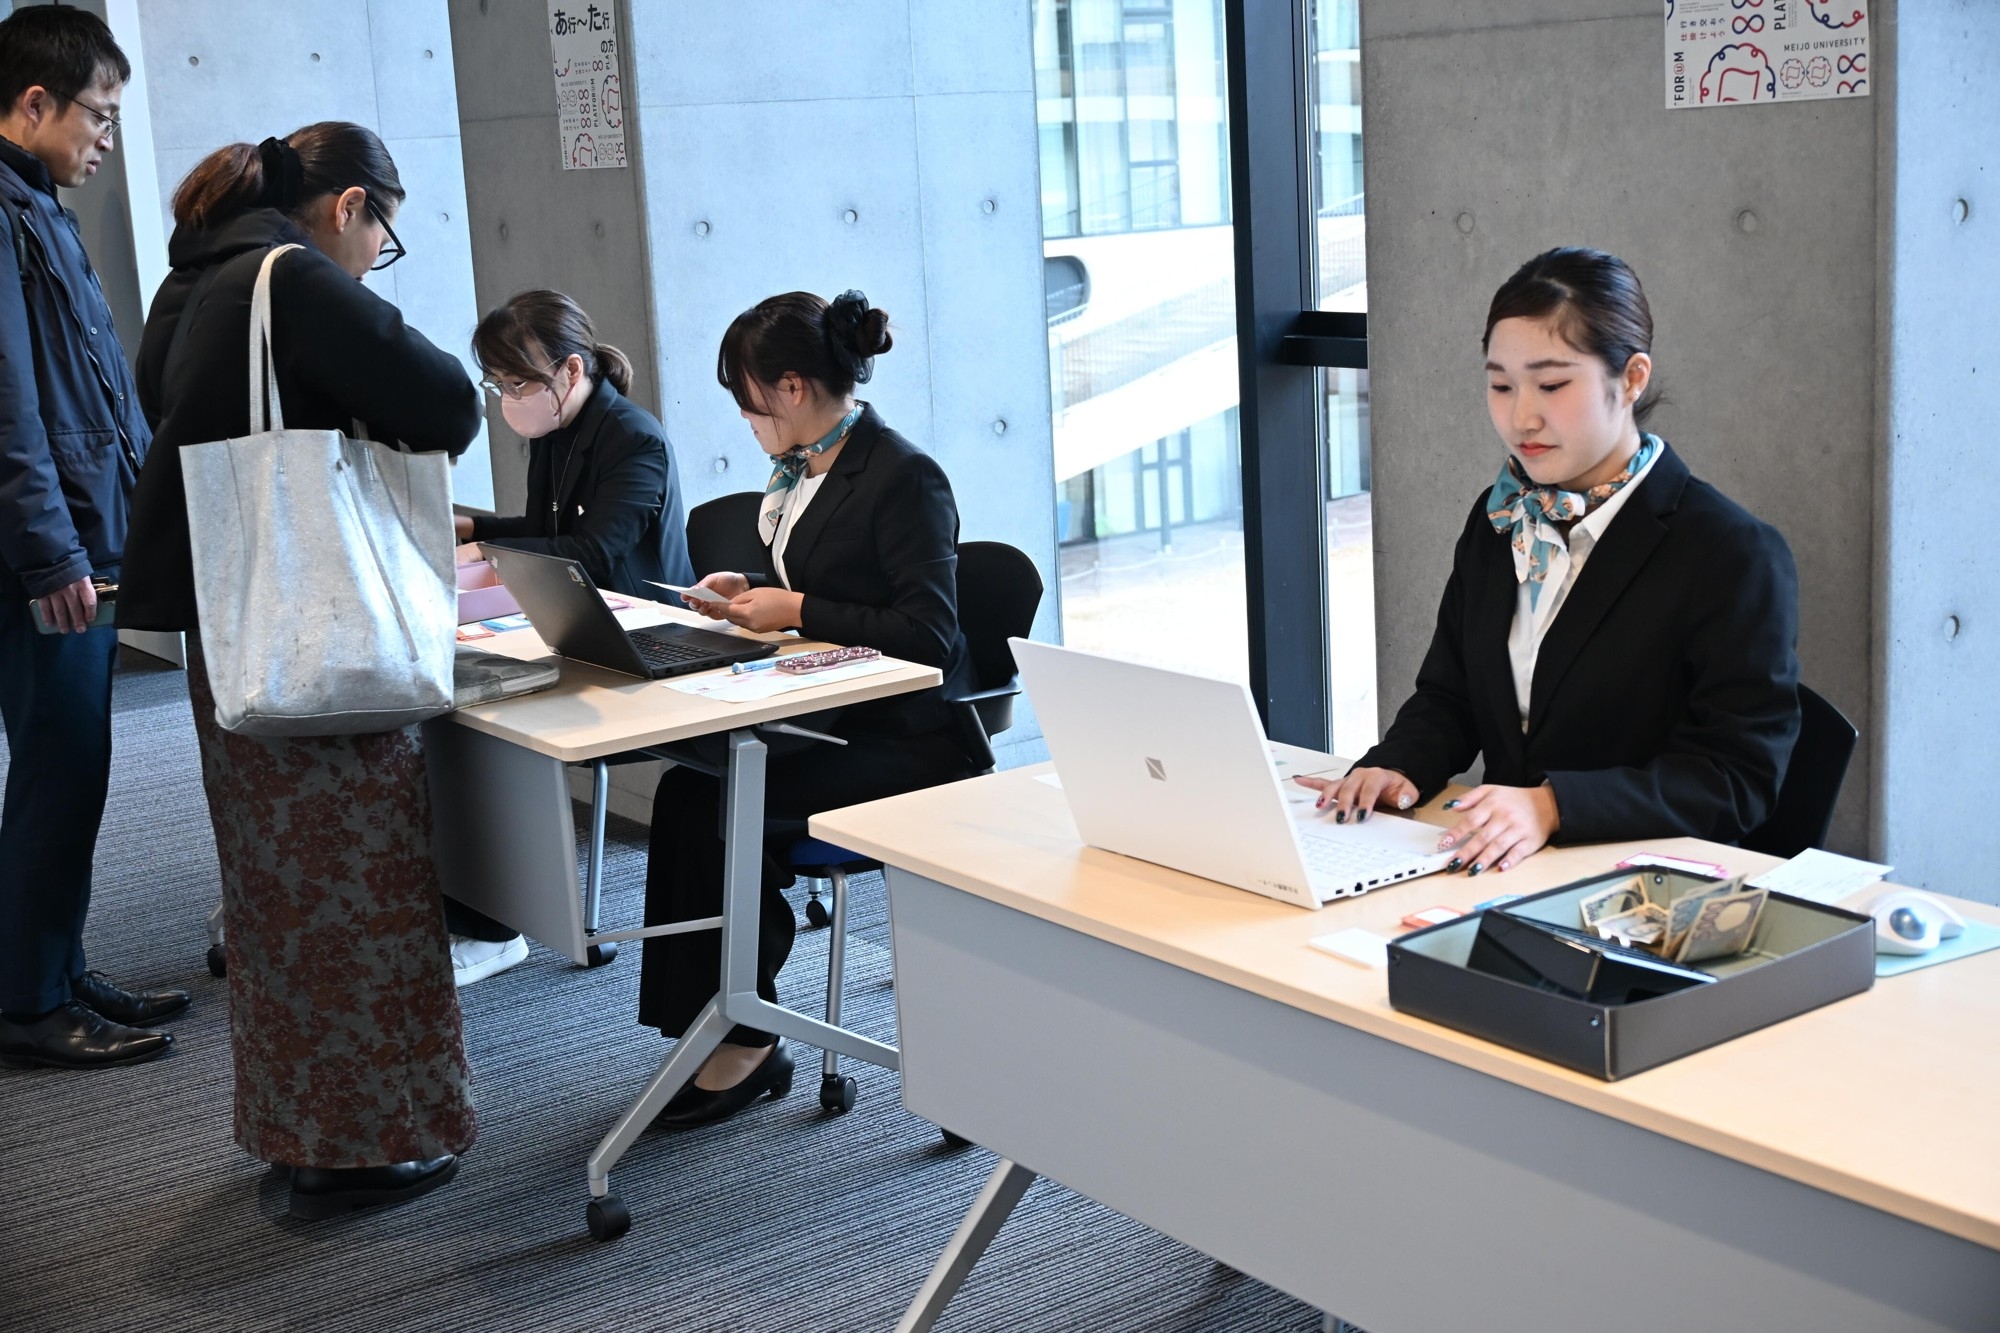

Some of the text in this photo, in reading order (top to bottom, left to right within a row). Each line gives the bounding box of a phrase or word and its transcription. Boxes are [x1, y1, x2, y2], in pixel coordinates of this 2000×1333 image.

[601, 38, 614, 53] の方
[1783, 37, 1866, 52] MEIJO UNIVERSITY
[1673, 52, 1685, 105] FORUM
